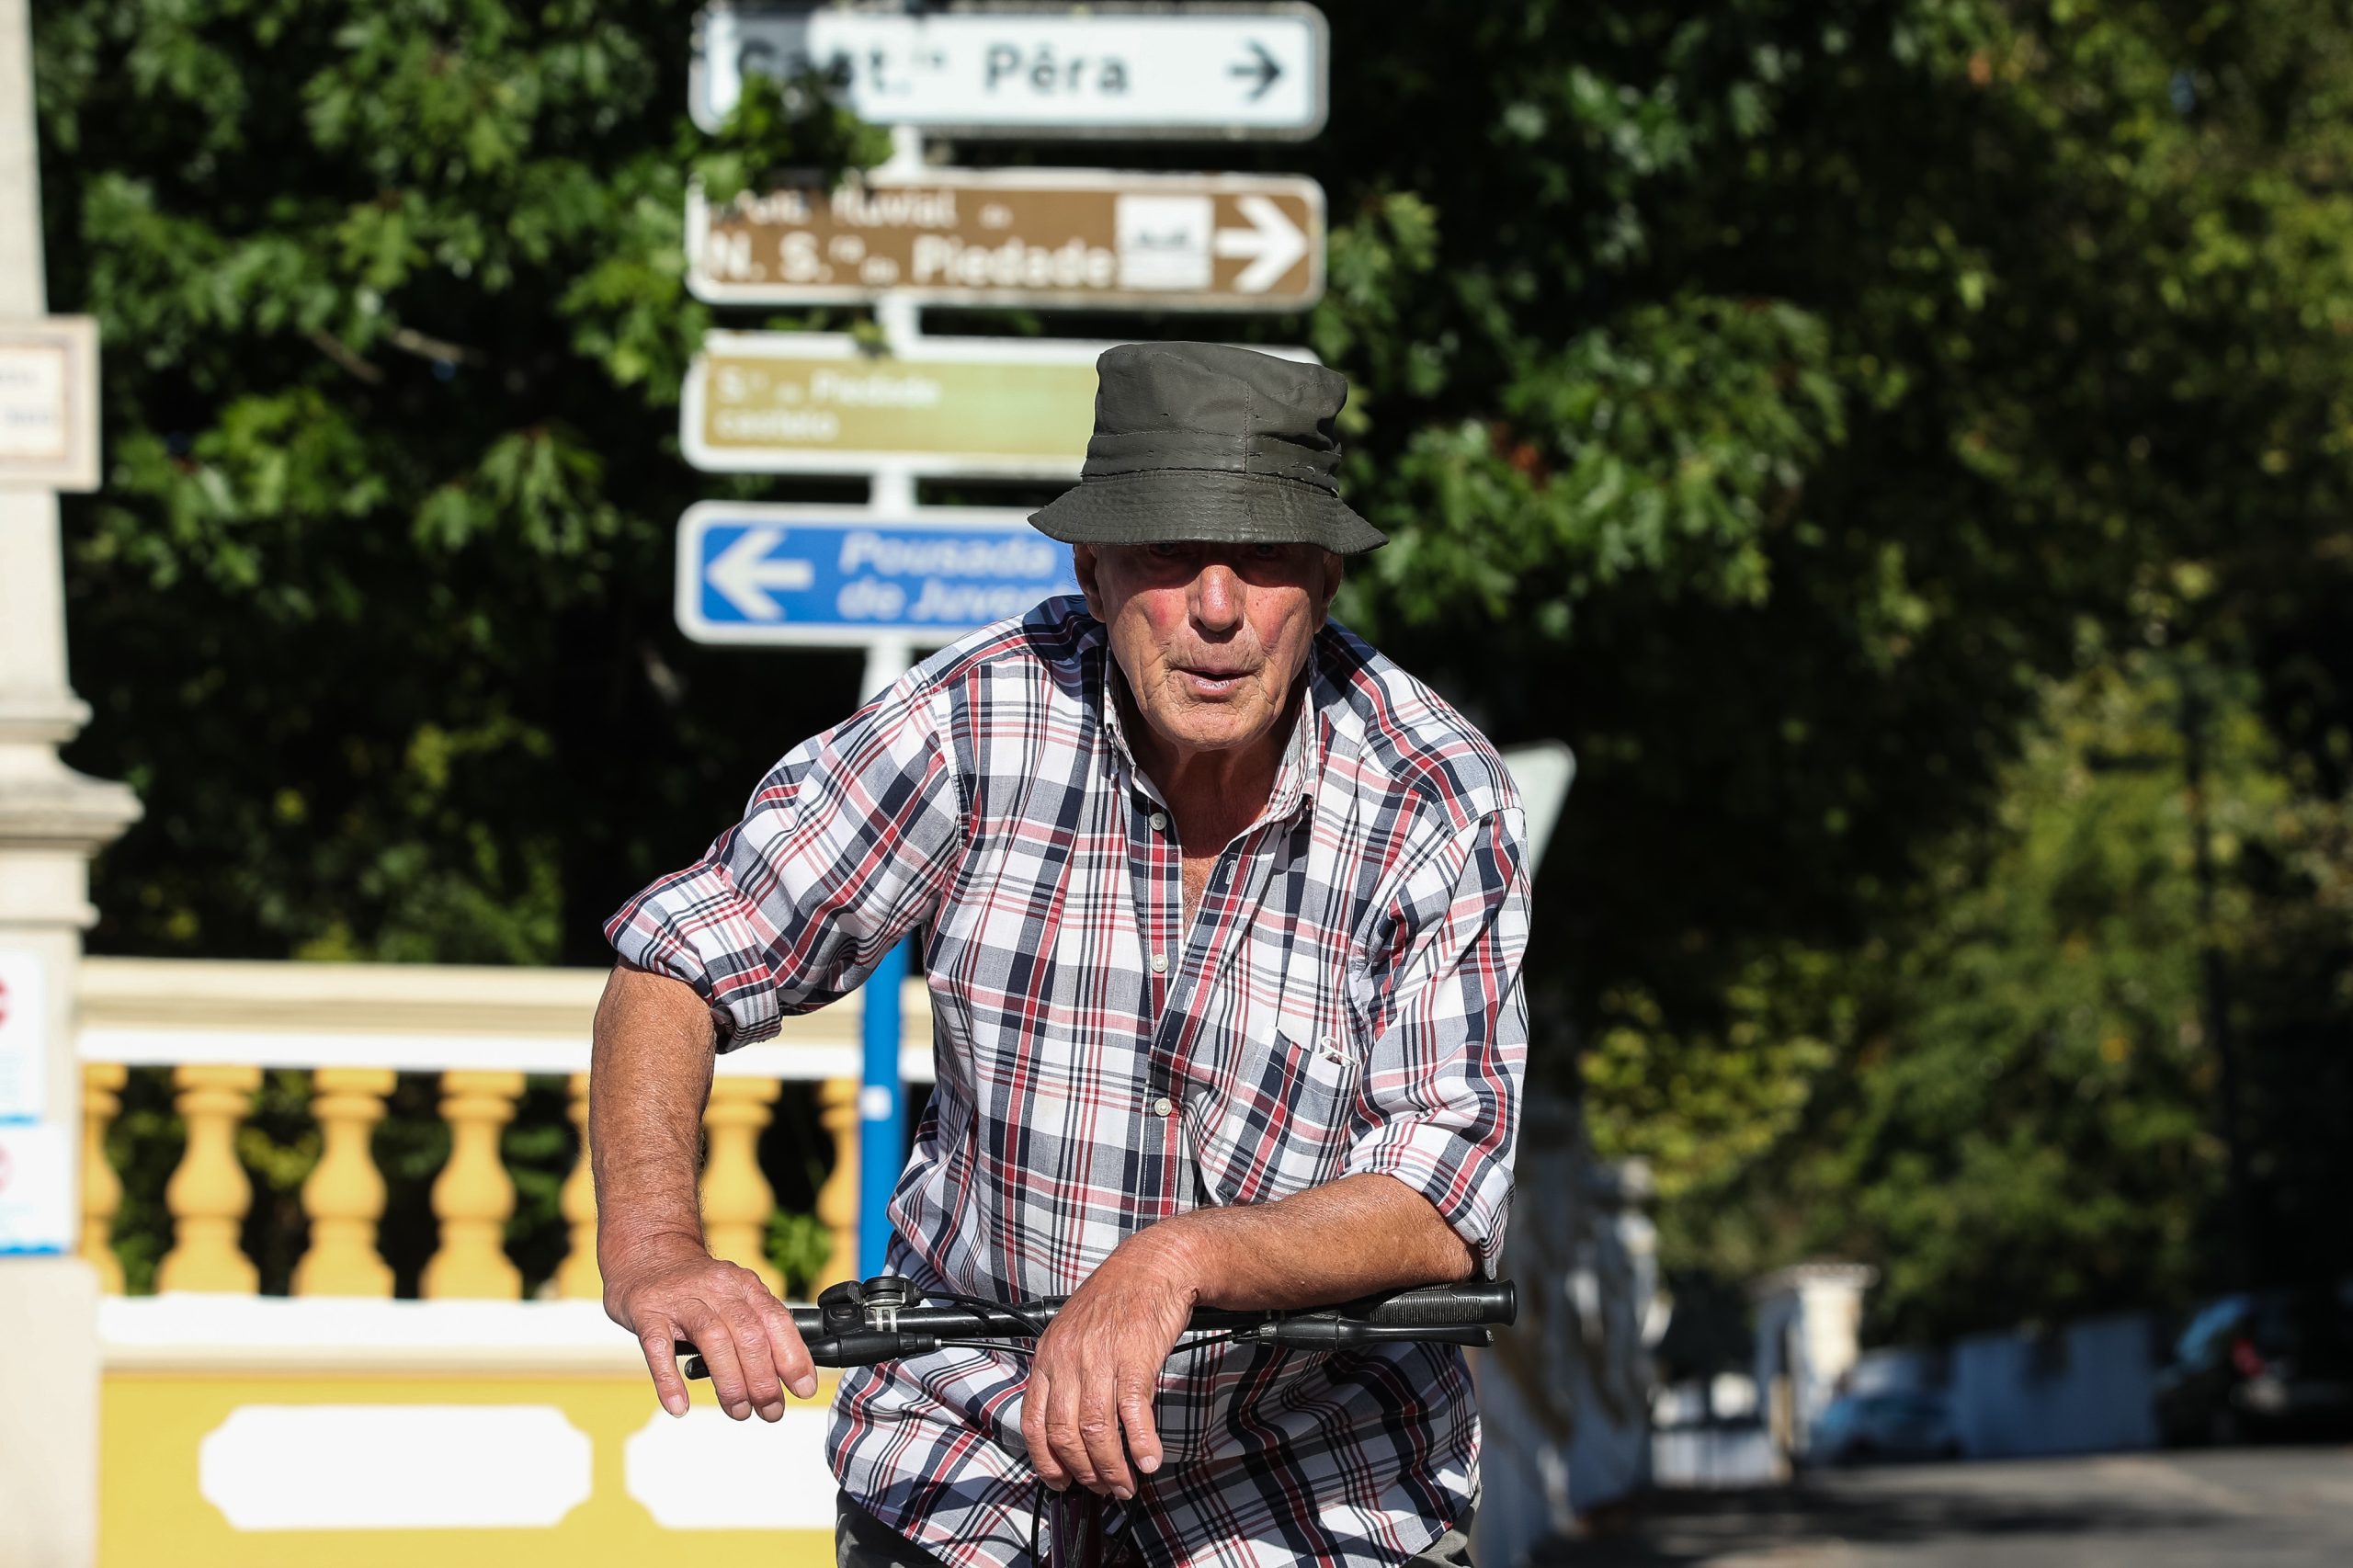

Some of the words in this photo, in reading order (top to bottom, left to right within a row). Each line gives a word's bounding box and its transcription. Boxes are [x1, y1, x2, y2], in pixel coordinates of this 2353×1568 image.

[983, 41, 1131, 92] Pêra
[914, 234, 1119, 288] Piedade
[811, 368, 940, 407] Piedade
[839, 531, 1056, 578] Pousada
[836, 574, 906, 621] de
